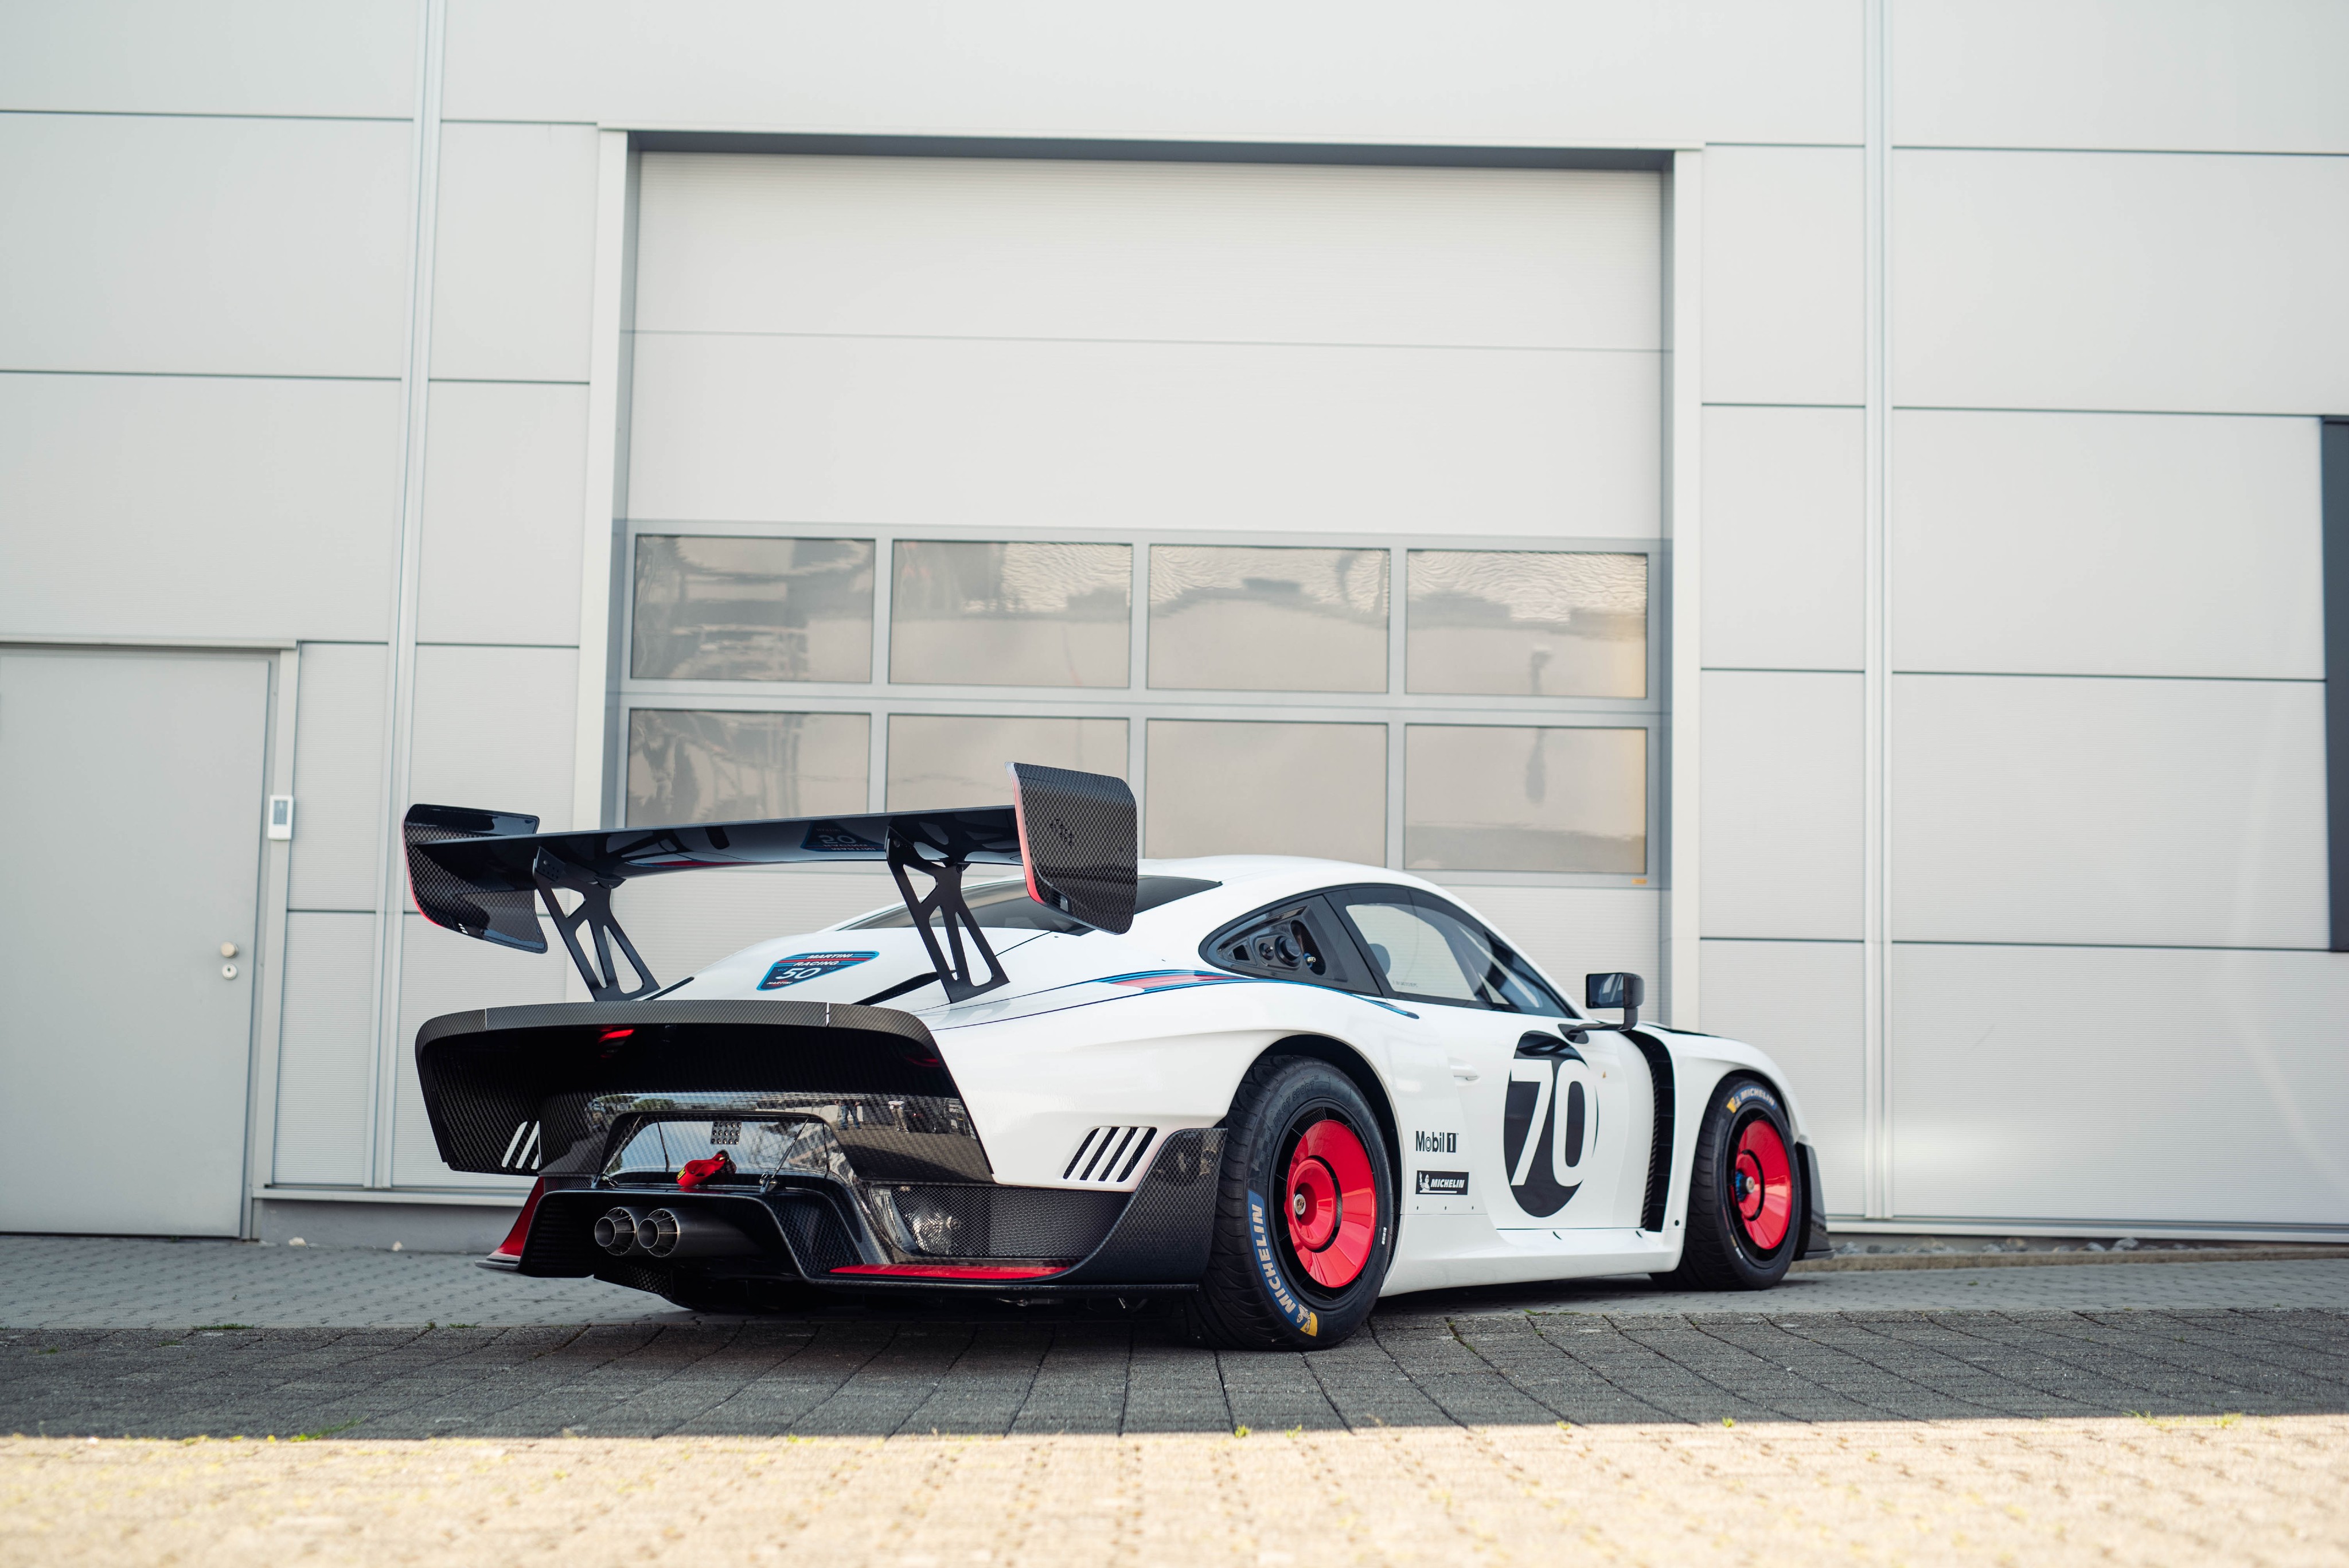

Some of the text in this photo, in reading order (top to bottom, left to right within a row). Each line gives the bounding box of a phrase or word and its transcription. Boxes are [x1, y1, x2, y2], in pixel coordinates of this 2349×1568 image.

[775, 968, 821, 979] 50
[1273, 1081, 1315, 1128] PILOT SPORT
[1741, 1088, 1775, 1106] MICHELIN
[1511, 1058, 1597, 1187] 70
[1415, 1130, 1445, 1152] Mobil
[1430, 1179, 1465, 1188] MICHELIN
[1252, 1204, 1296, 1314] MICHELIN
